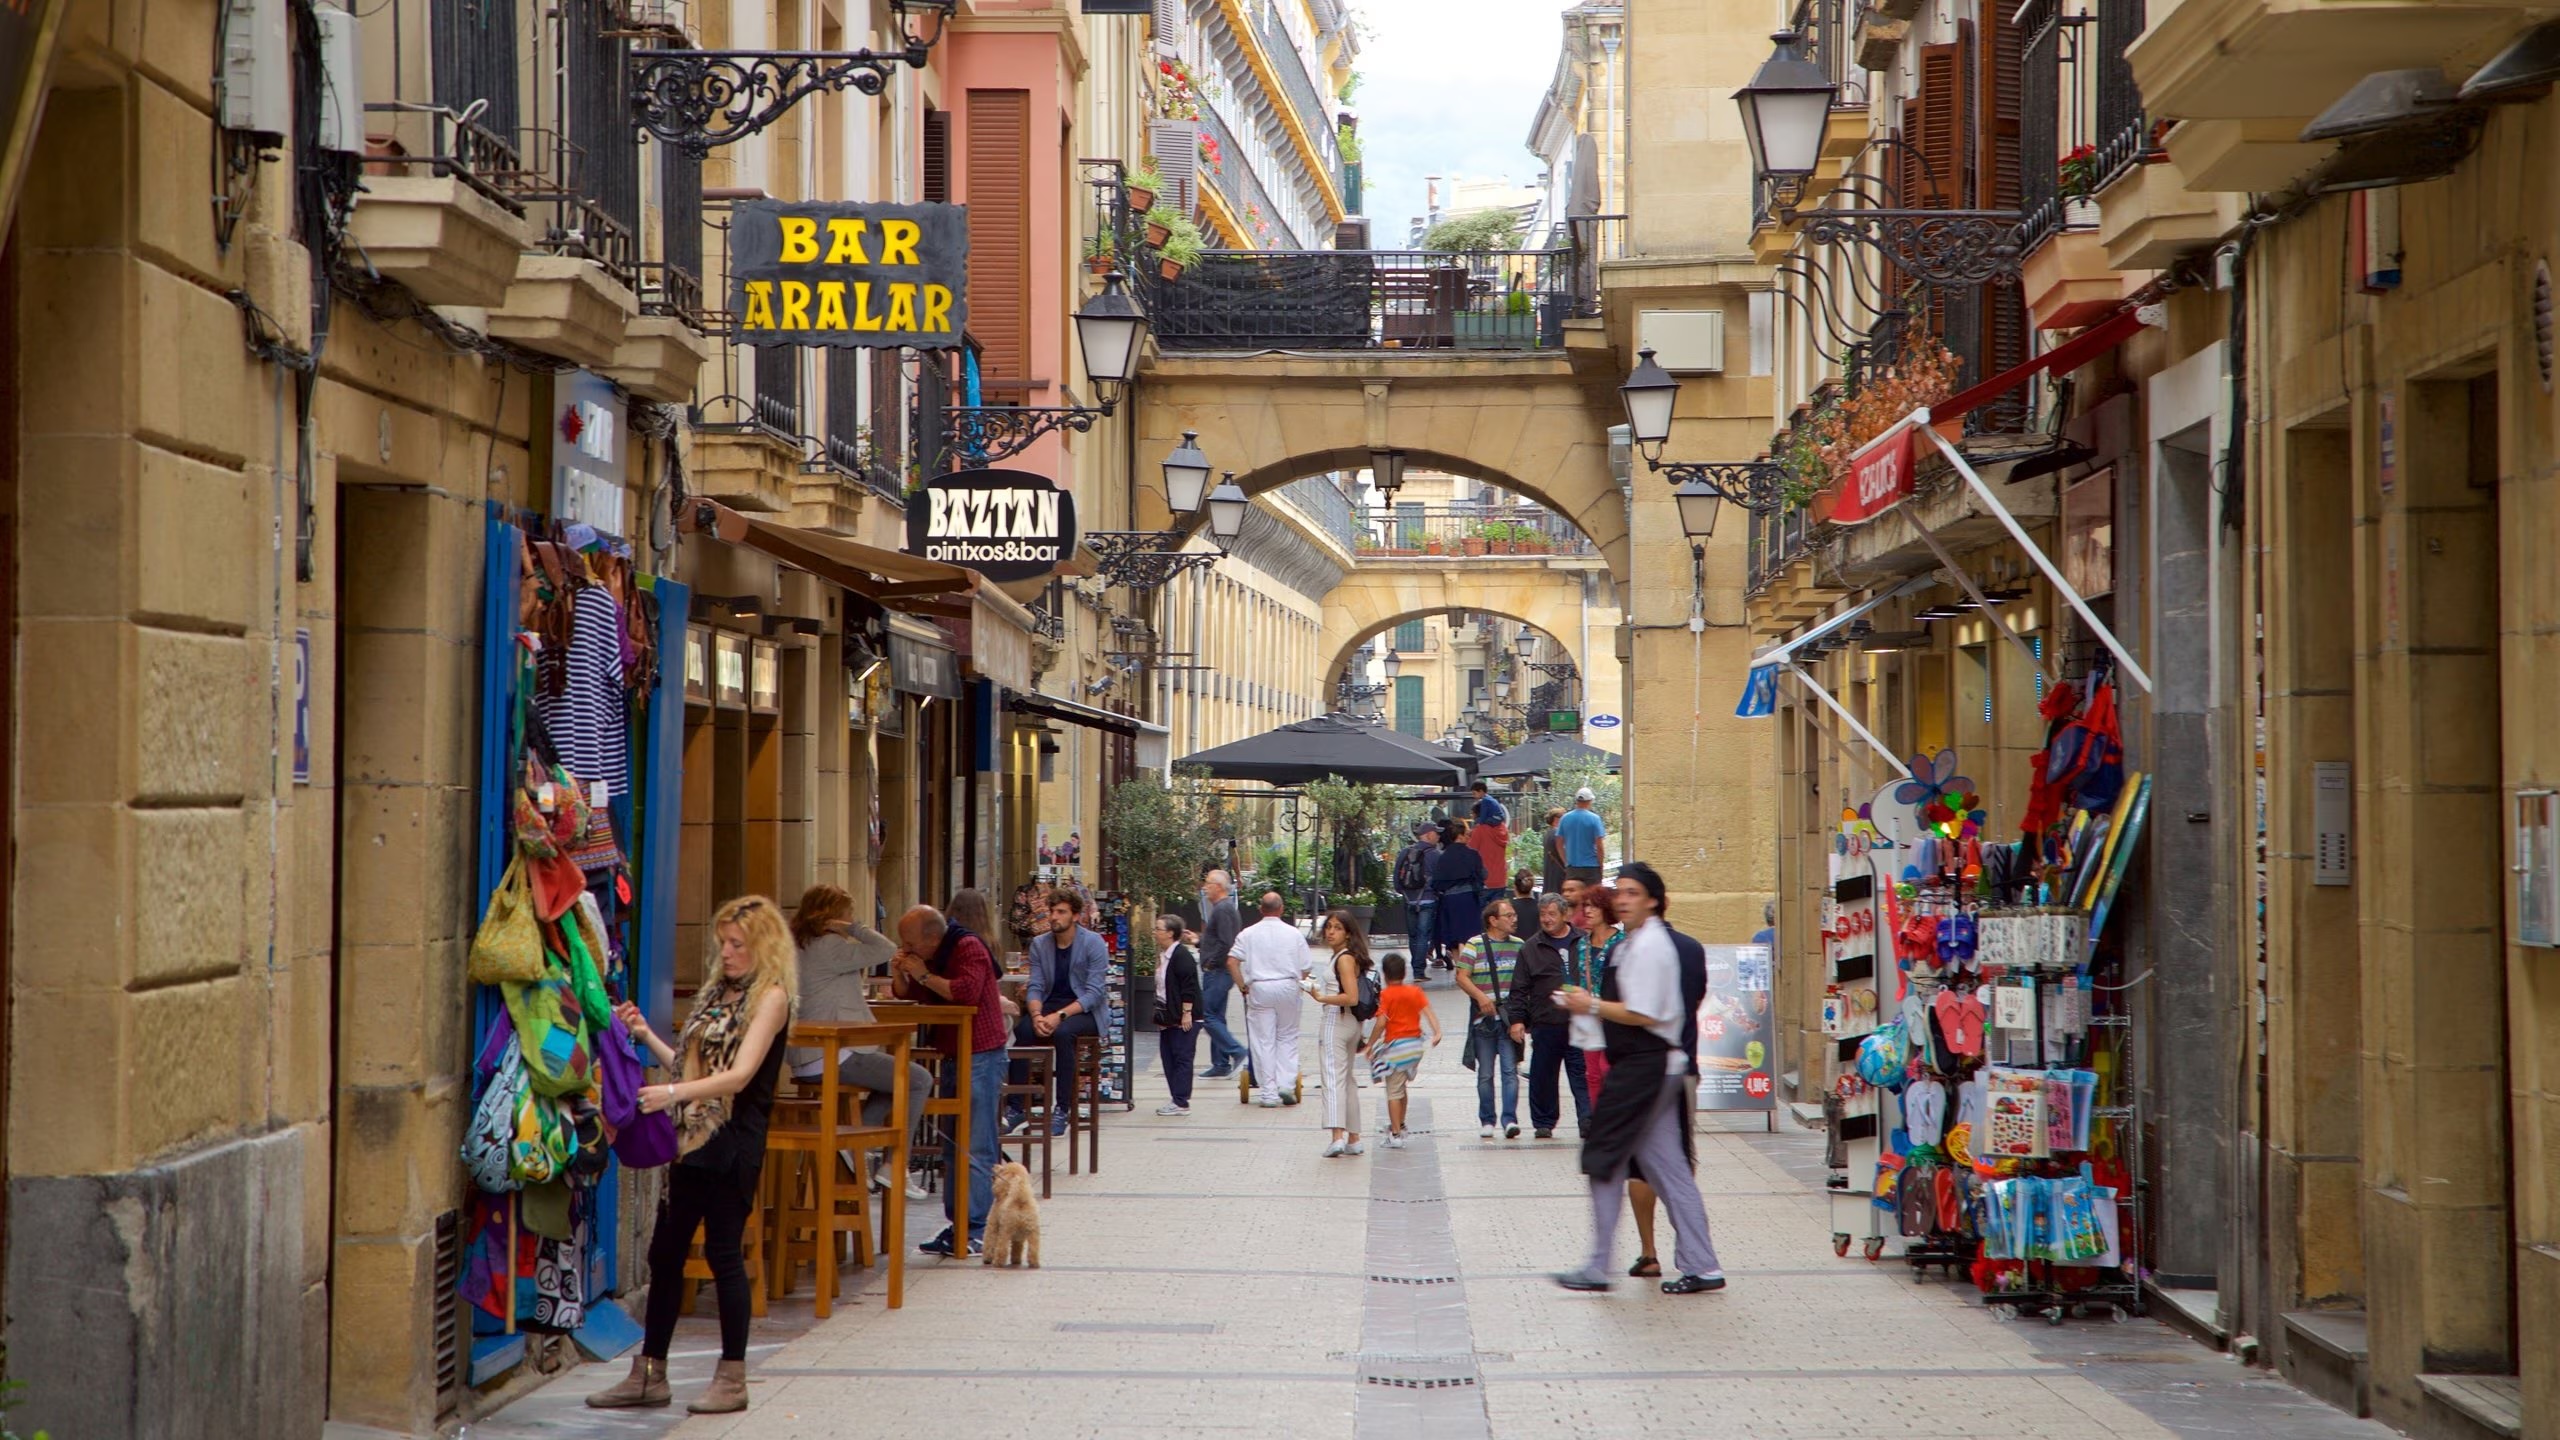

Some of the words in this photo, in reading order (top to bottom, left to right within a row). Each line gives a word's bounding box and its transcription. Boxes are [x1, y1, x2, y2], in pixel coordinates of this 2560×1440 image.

[777, 216, 922, 265] BAR
[742, 280, 954, 333] ARALAR
[926, 487, 1060, 539] BAZTAN
[926, 541, 1060, 562] pintxos&bar
